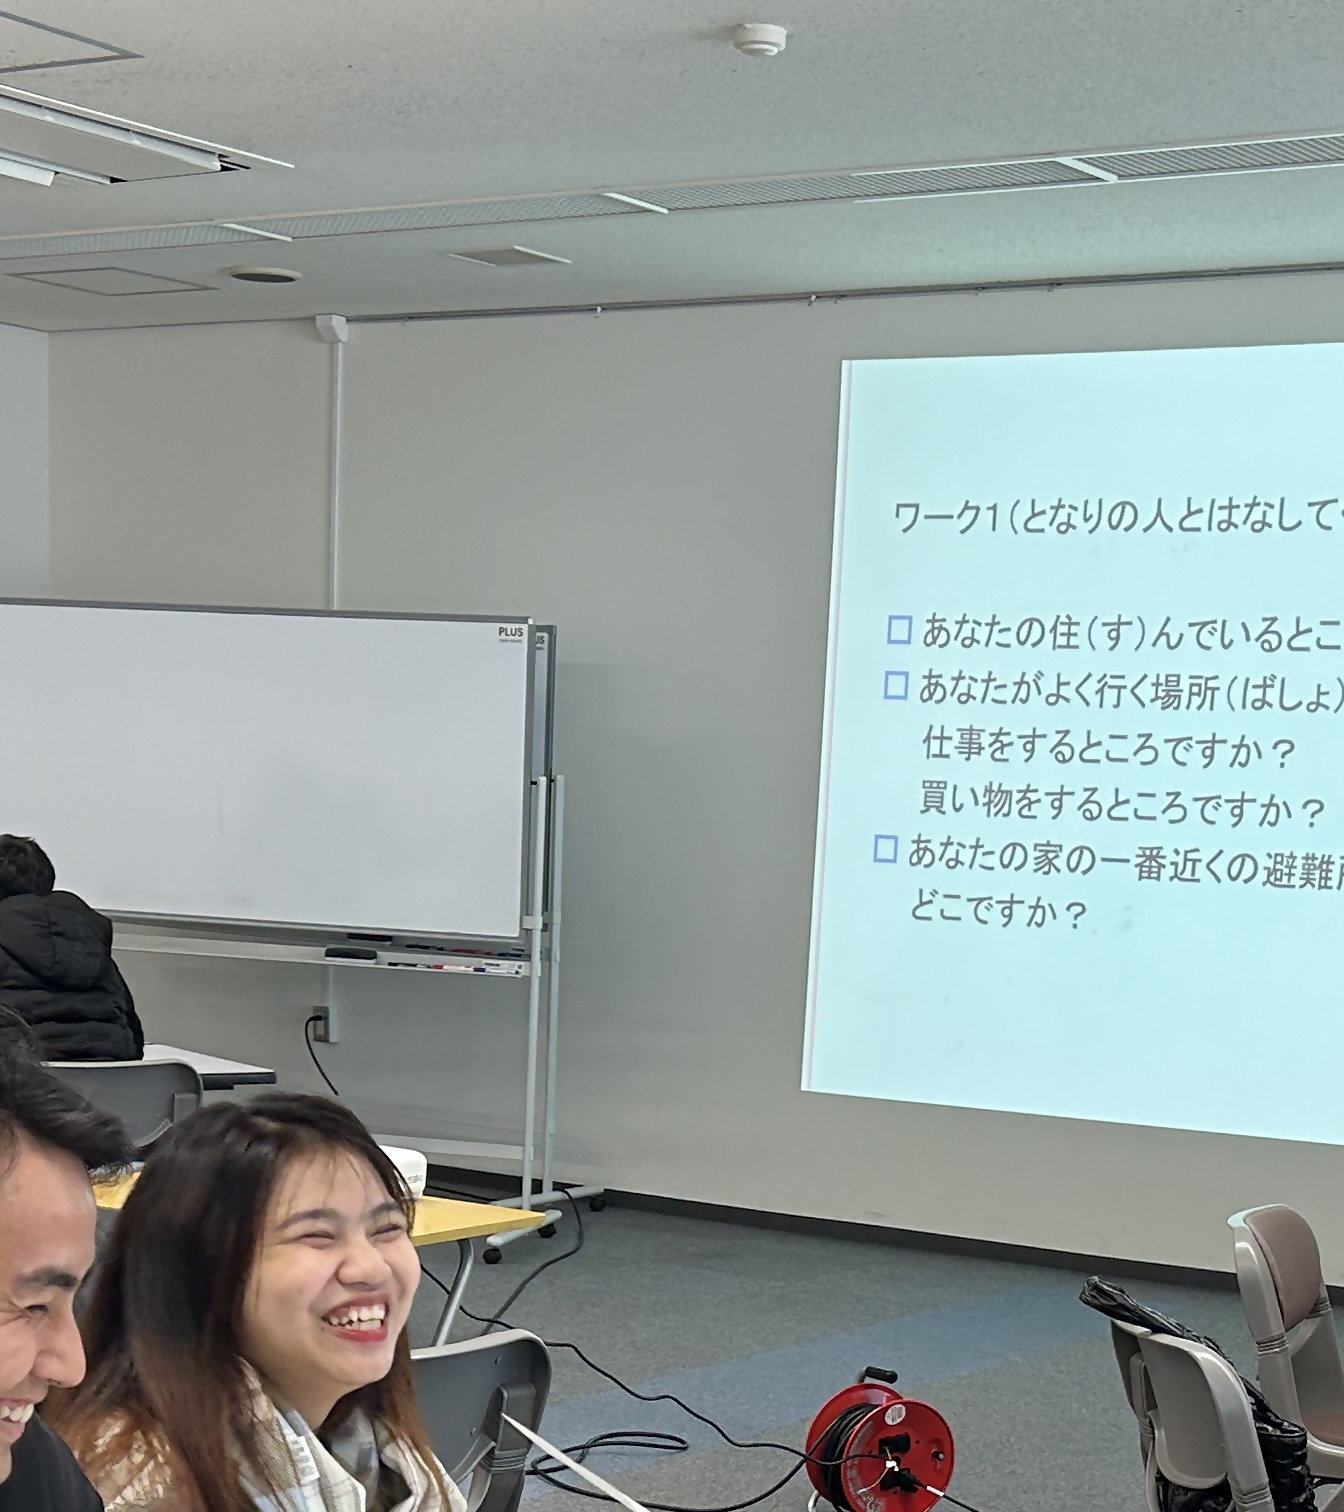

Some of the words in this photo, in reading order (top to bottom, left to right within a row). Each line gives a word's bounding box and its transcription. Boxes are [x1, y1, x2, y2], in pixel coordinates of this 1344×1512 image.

[498, 627, 524, 637] PLUS
[921, 722, 1297, 771] 仕事をするところですか？
[918, 778, 1326, 830] 買い物をするところですか？
[910, 886, 1089, 930] どこですか？
